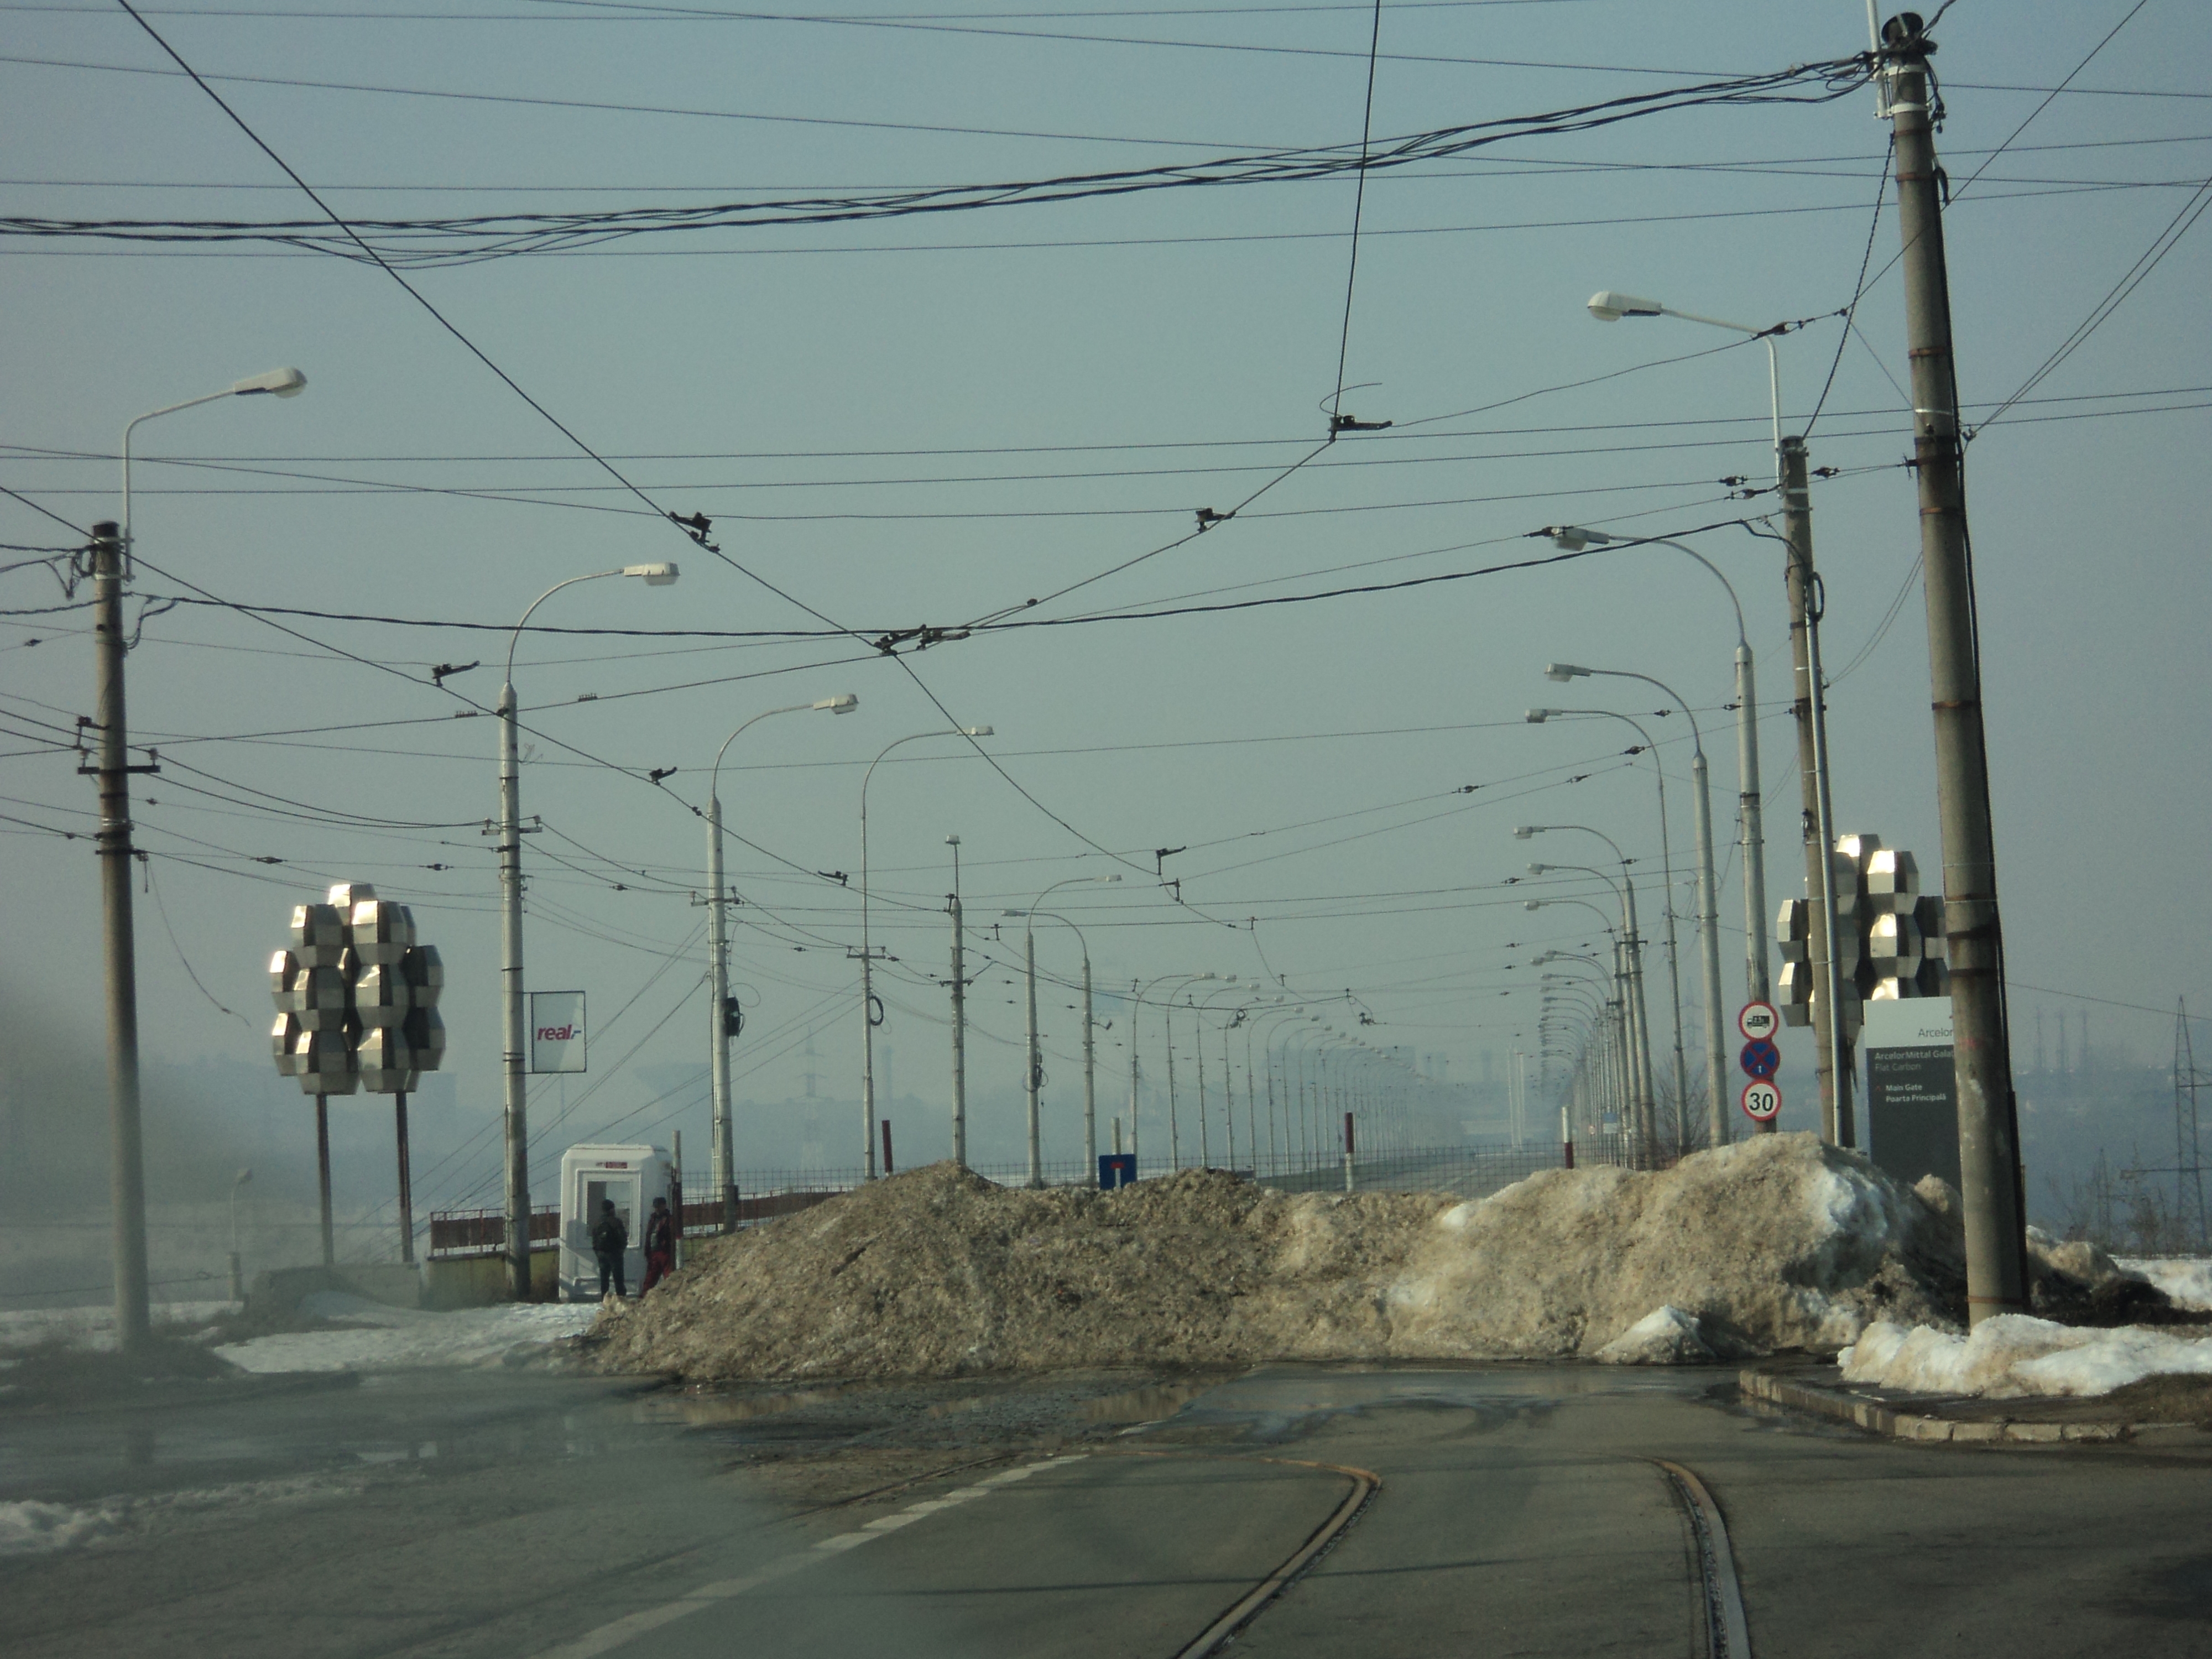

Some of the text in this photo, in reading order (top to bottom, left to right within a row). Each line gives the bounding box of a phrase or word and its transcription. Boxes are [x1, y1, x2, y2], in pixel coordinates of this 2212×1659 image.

[1875, 1051, 1931, 1060] ArcelorMittal
[1875, 1062, 1922, 1071] Flat Carbon
[1750, 1092, 1773, 1112] 30
